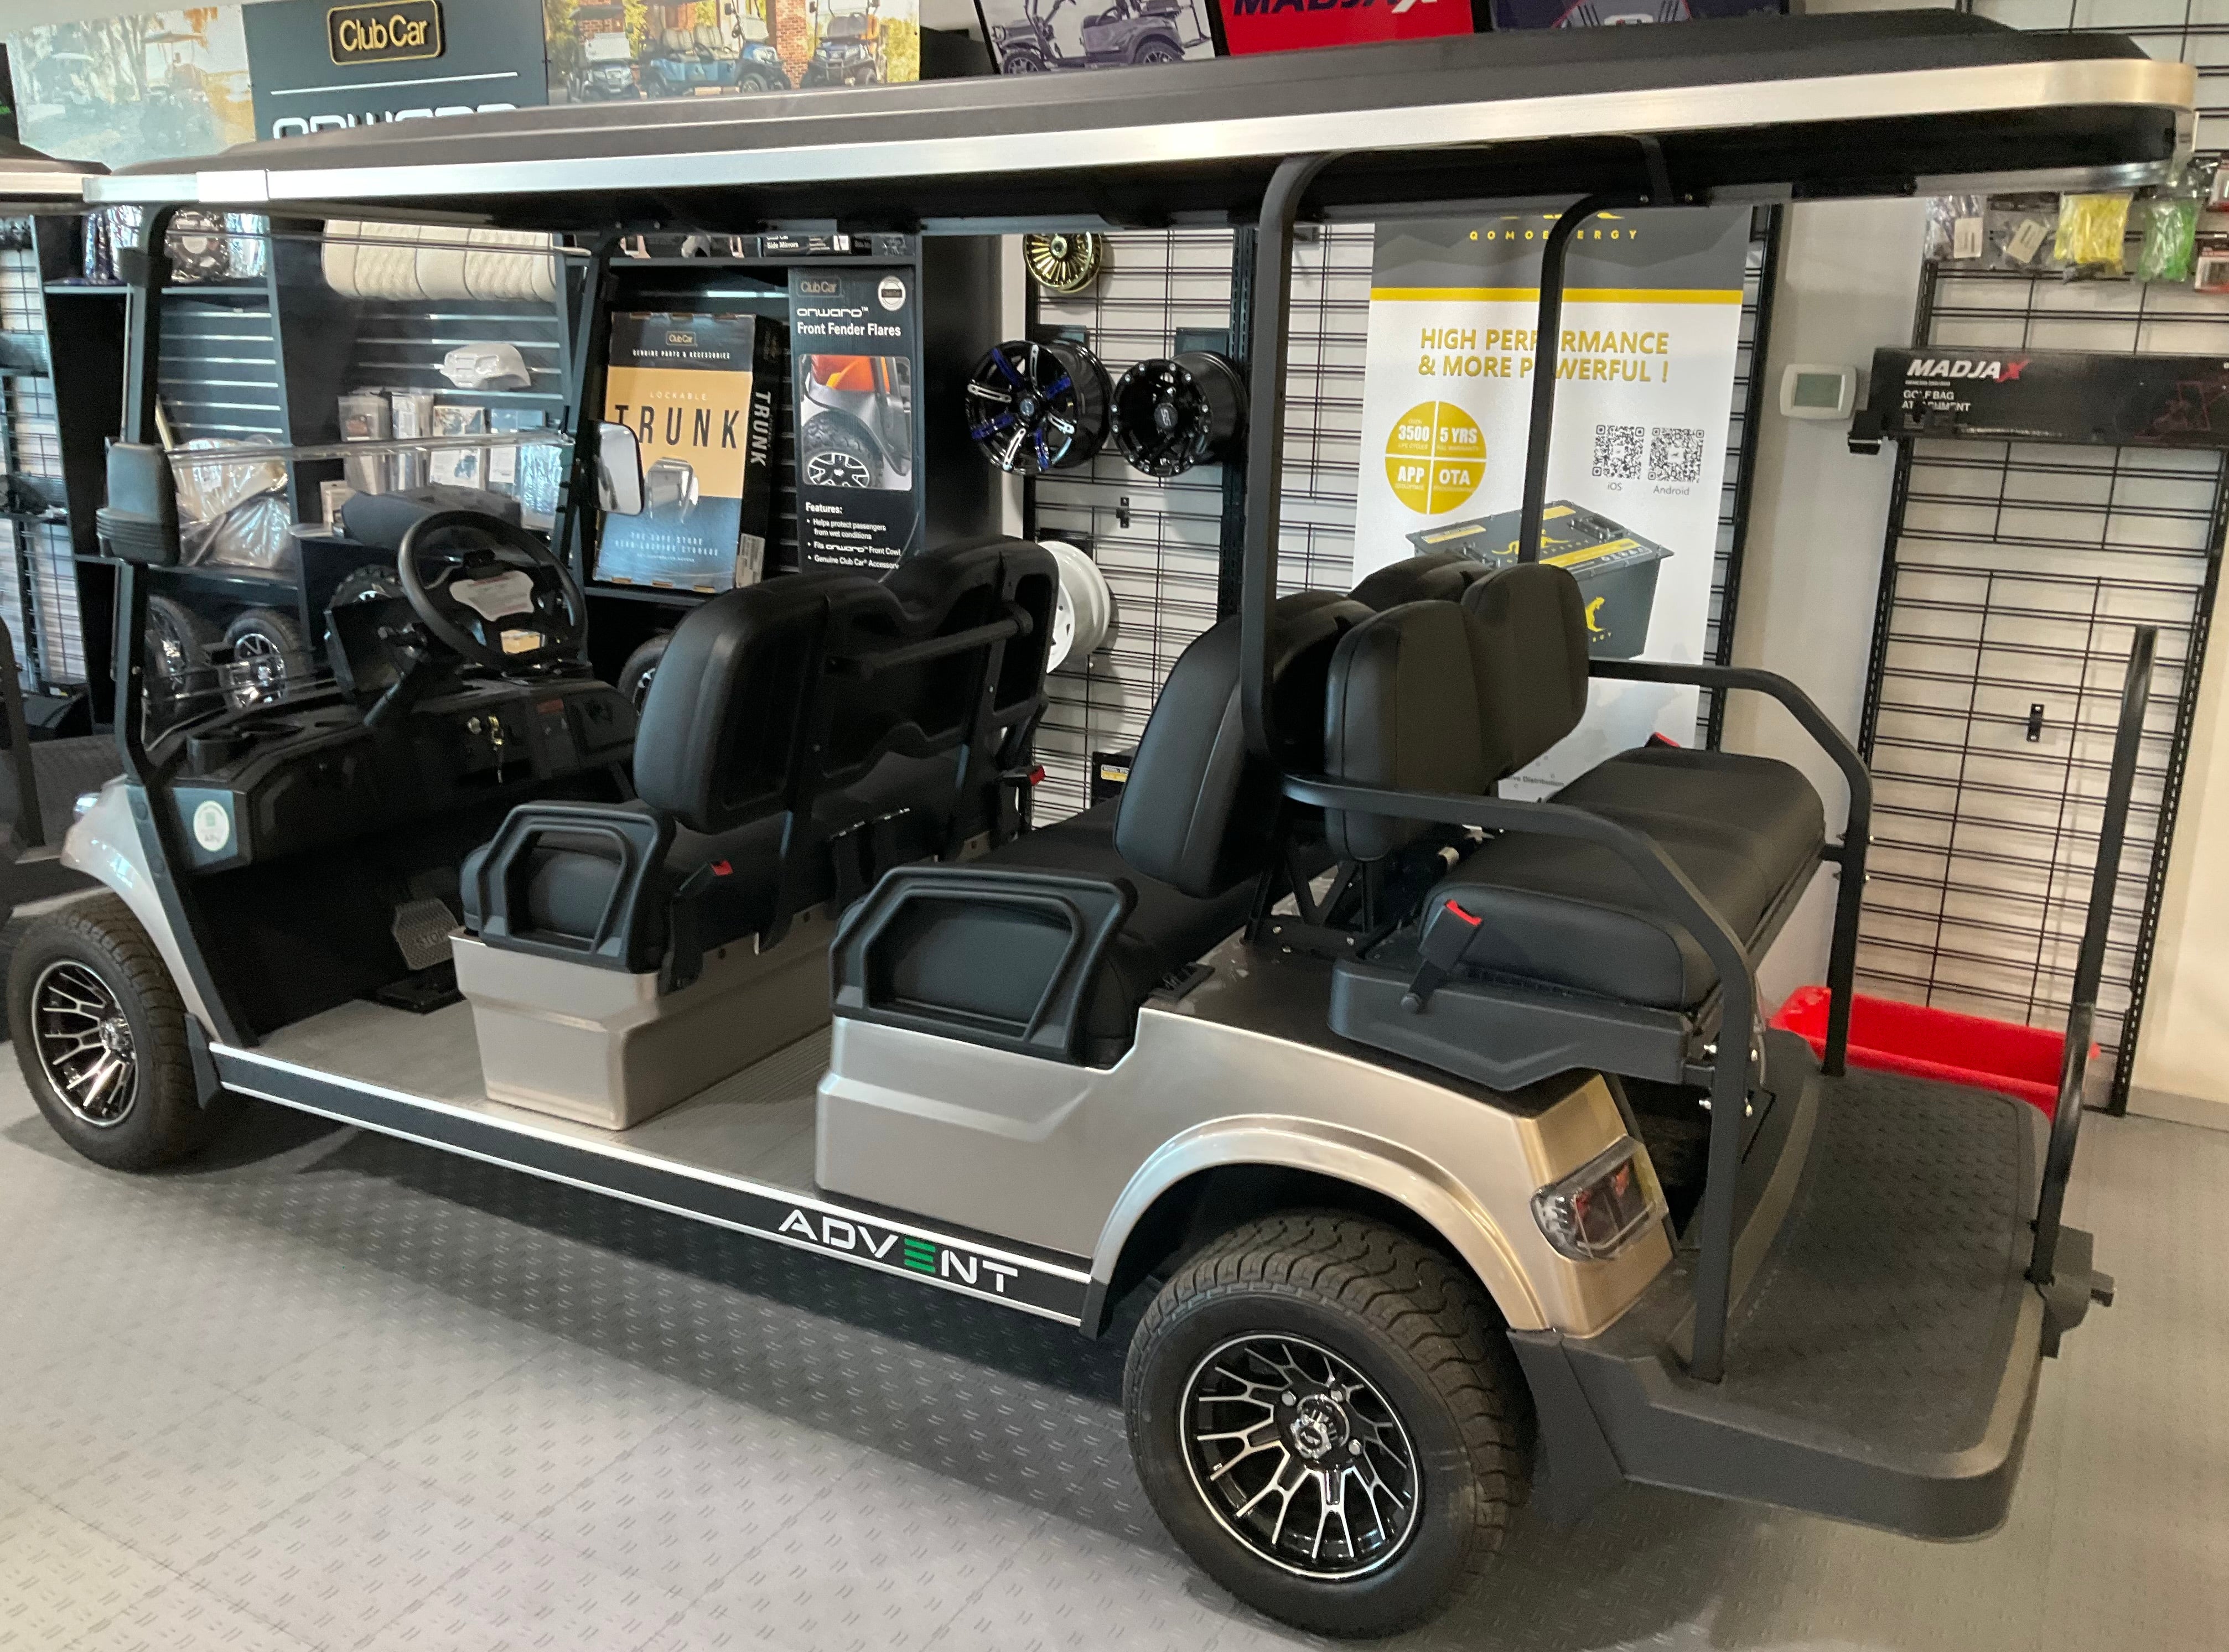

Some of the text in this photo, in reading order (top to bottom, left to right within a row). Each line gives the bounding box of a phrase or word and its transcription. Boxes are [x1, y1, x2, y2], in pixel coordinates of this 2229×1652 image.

[339, 14, 428, 52] Club Car
[1469, 229, 1637, 241] QOMOEERGY
[797, 321, 901, 336] Front Fender Flares
[1421, 328, 1670, 355] HIGH PERFRMANCE
[1418, 354, 1435, 376] &
[1443, 355, 1512, 378] MORE
[1520, 357, 1651, 382] PWERFUL
[1906, 356, 2031, 383] MADJAX
[650, 391, 708, 401] LOCKABLE
[1932, 391, 1955, 401] BAG
[615, 404, 740, 449] TRUNK
[750, 390, 771, 467] TRUNK
[1398, 424, 1430, 442] 3500
[1439, 427, 1478, 444] 5 YRS
[1397, 465, 1425, 483] APP
[1439, 469, 1471, 485] OTA
[1607, 482, 1622, 491] iOS
[1652, 485, 1690, 496] Android
[805, 501, 843, 514] Features:
[812, 517, 887, 532] Helps protect passengers
[813, 527, 828, 537] from
[841, 531, 873, 541] conditions
[813, 541, 825, 549] Fits
[868, 546, 885, 555] Front
[885, 547, 901, 556] Cowl
[813, 554, 839, 564] Genuine
[839, 556, 853, 565] Club
[778, 1209, 1018, 1293] ADVENT
